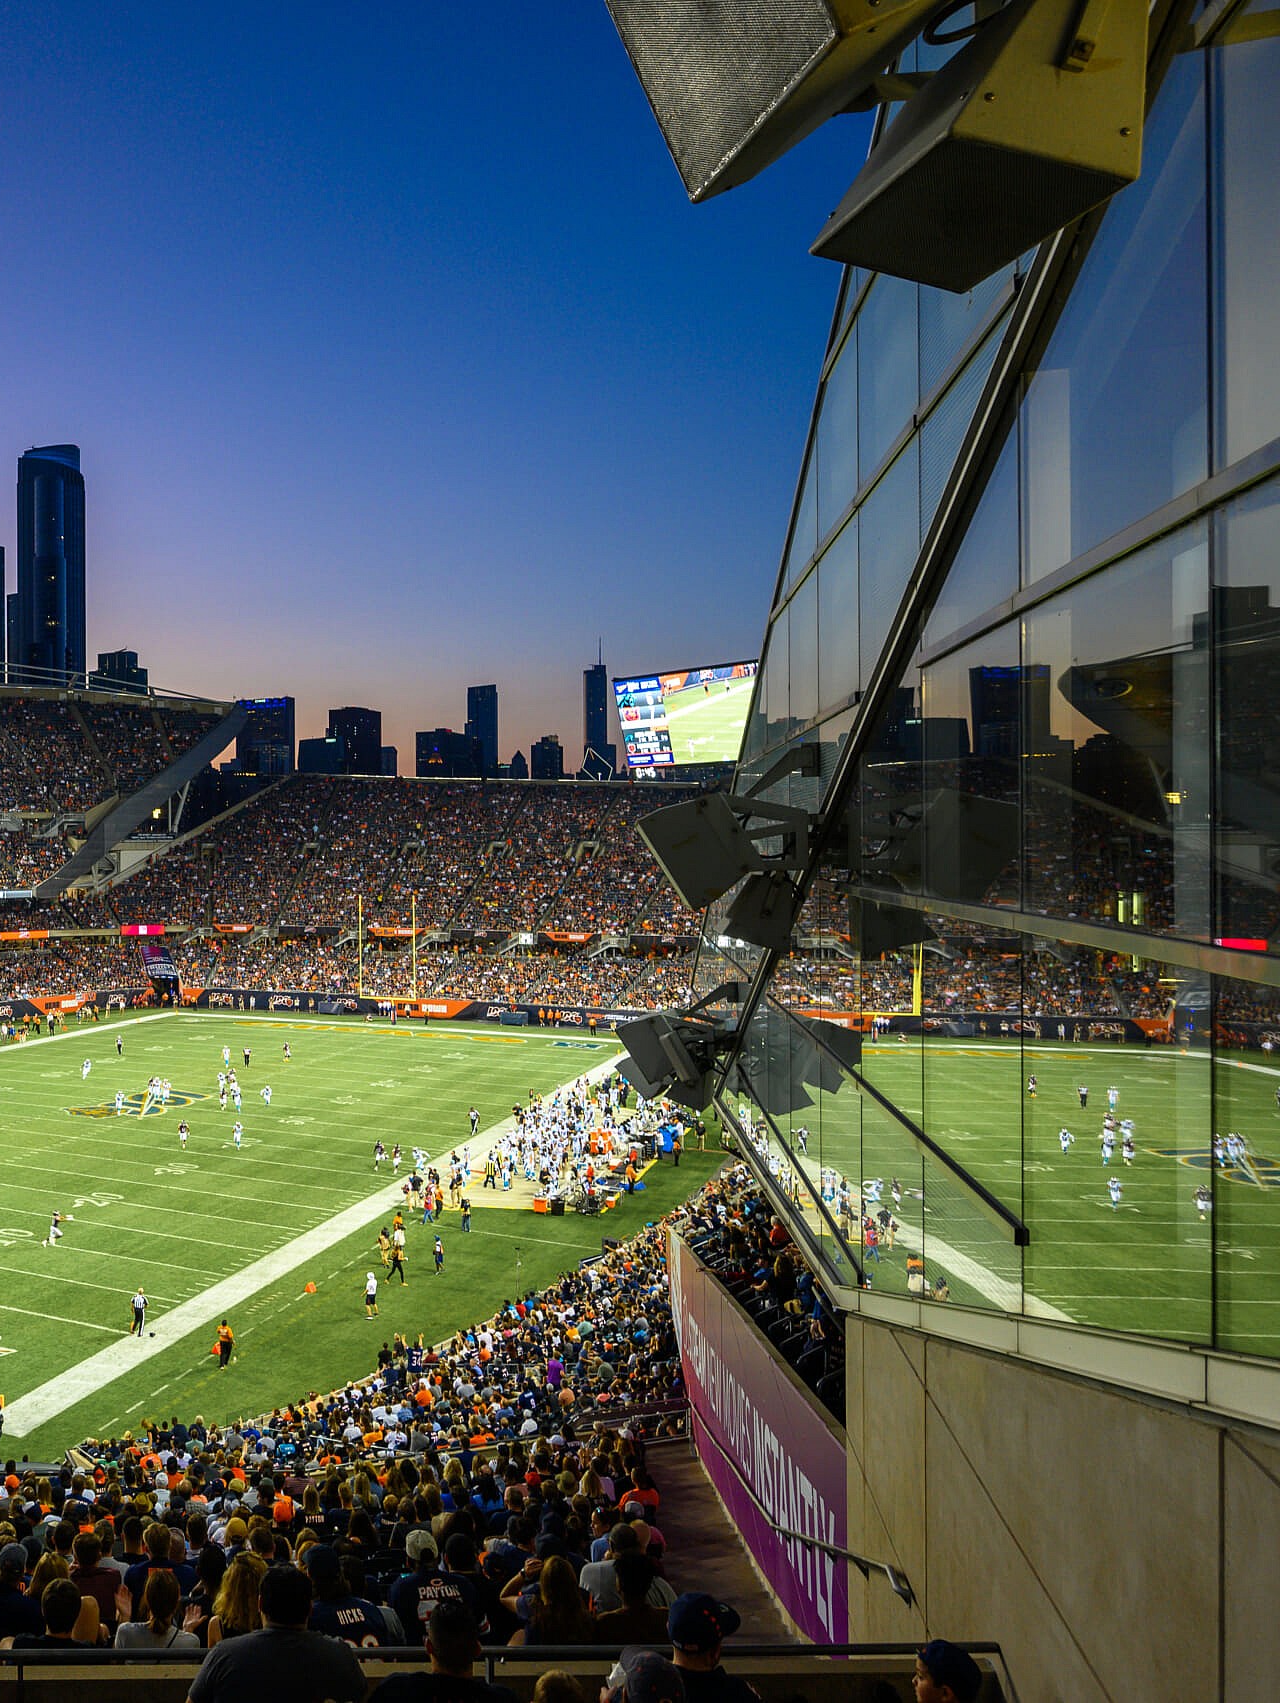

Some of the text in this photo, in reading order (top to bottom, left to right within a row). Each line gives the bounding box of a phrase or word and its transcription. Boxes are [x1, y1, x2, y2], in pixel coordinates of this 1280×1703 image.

[72, 1192, 125, 1208] 20
[753, 1406, 836, 1644] INSTANTLY
[418, 1584, 461, 1600] PAYTON
[336, 1607, 366, 1625] HICKS
